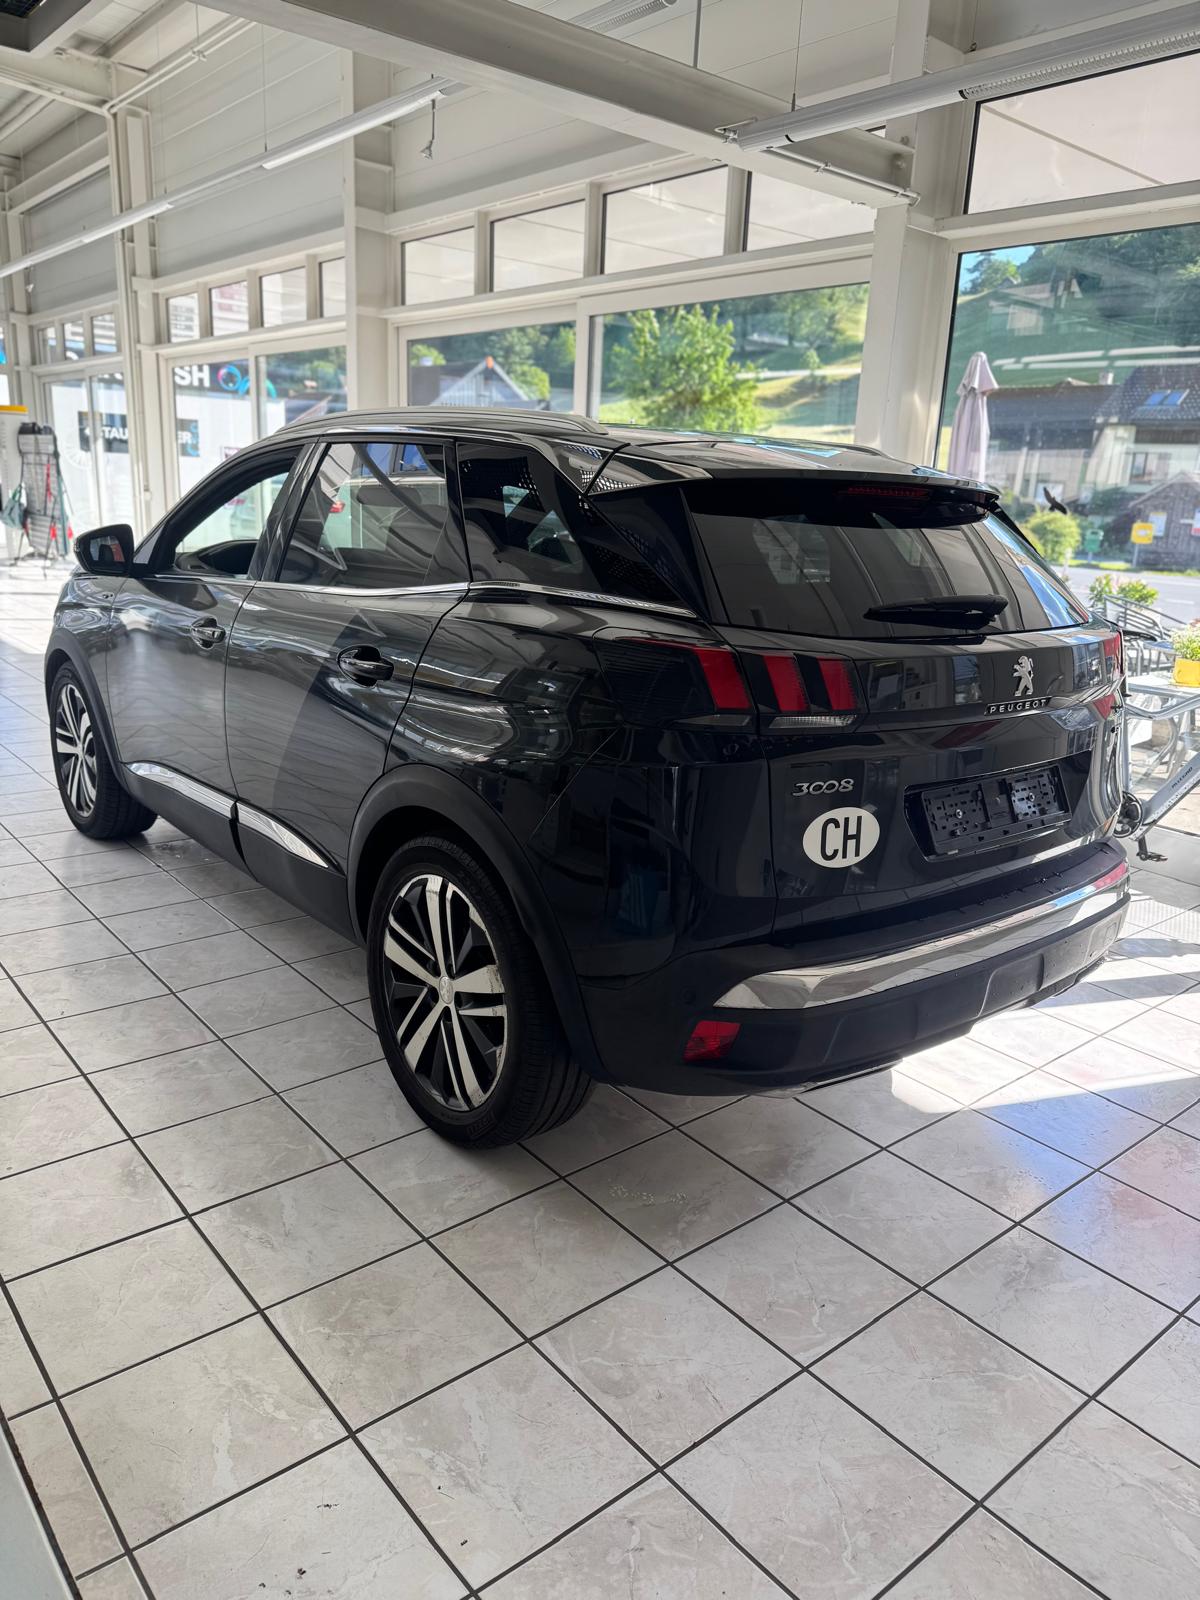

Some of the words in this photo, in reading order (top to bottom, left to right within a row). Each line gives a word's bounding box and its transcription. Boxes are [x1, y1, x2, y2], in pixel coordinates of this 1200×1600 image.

[989, 698, 1047, 714] PEUGEOT
[792, 778, 855, 797] 3008
[820, 815, 863, 861] CH
